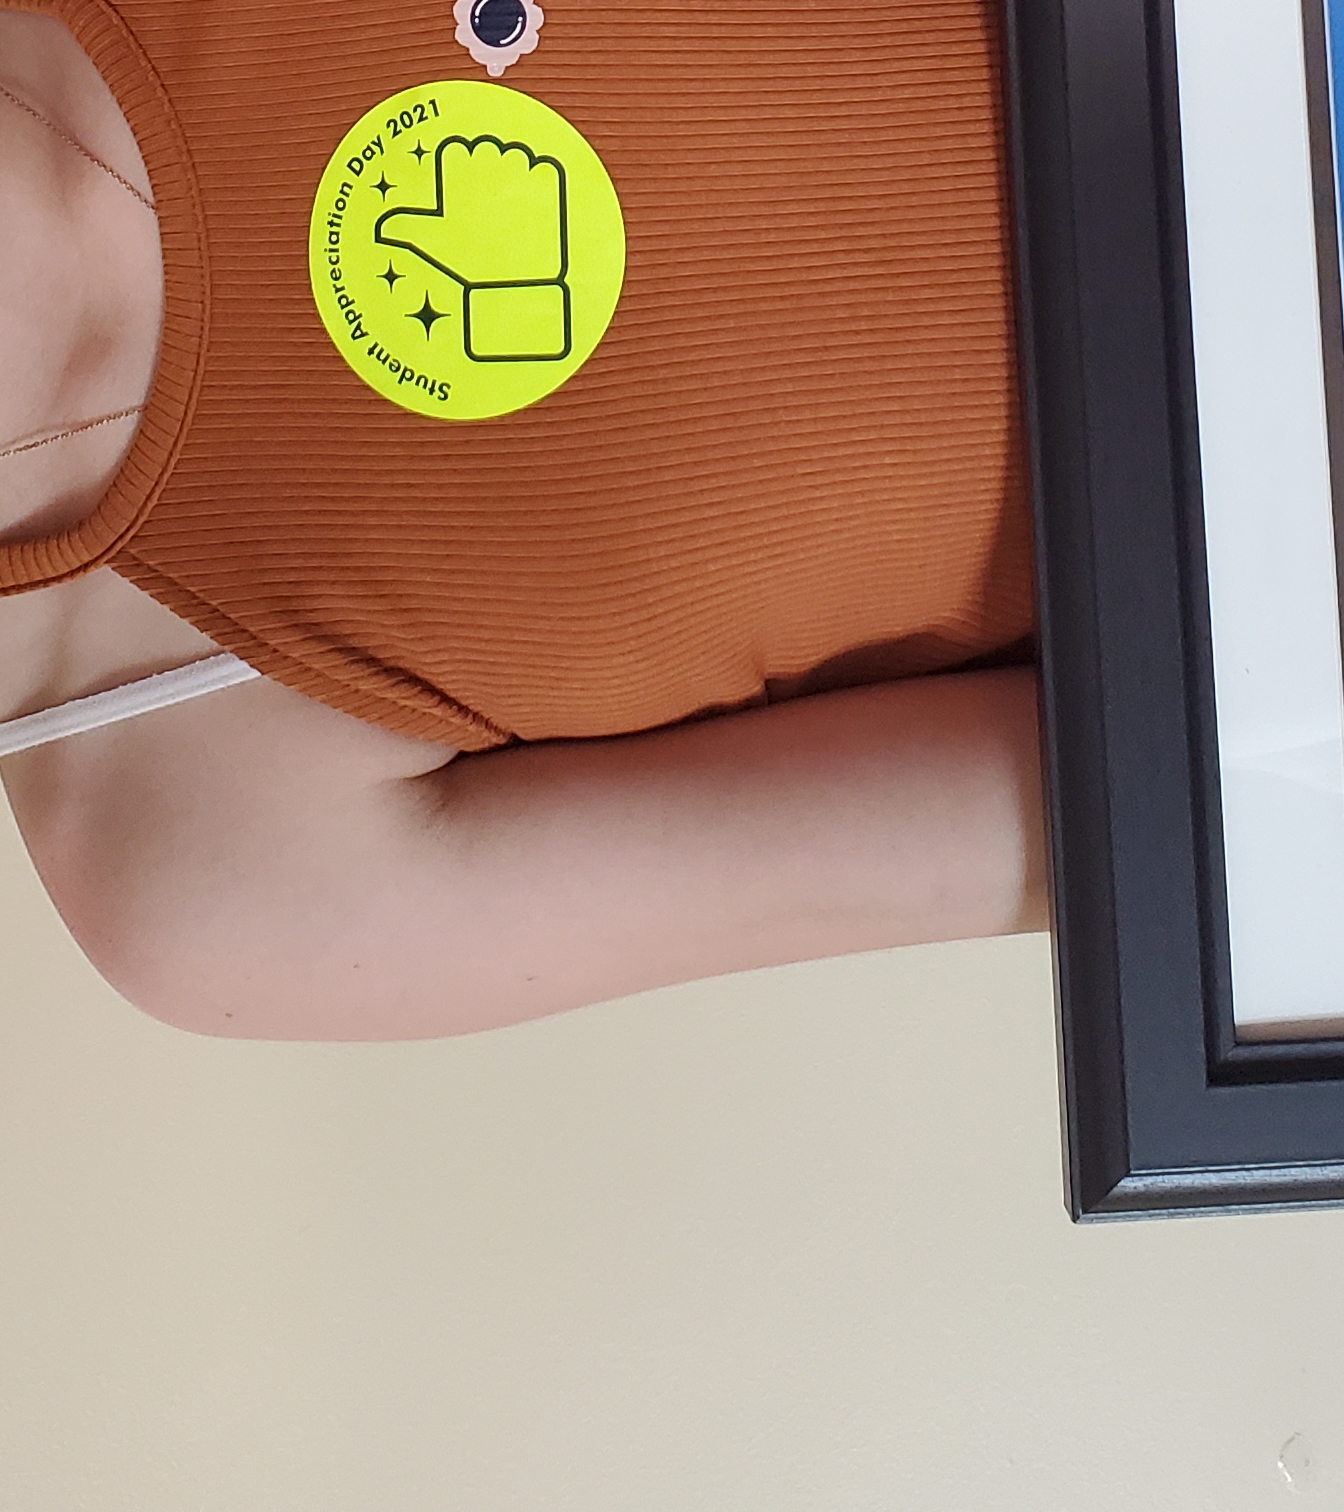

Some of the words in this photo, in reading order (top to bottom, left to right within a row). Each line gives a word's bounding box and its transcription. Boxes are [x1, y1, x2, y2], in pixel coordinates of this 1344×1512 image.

[384, 96, 442, 138] 2021
[345, 132, 386, 177] Day
[322, 179, 370, 341] Appreciation
[365, 340, 452, 401] Student
